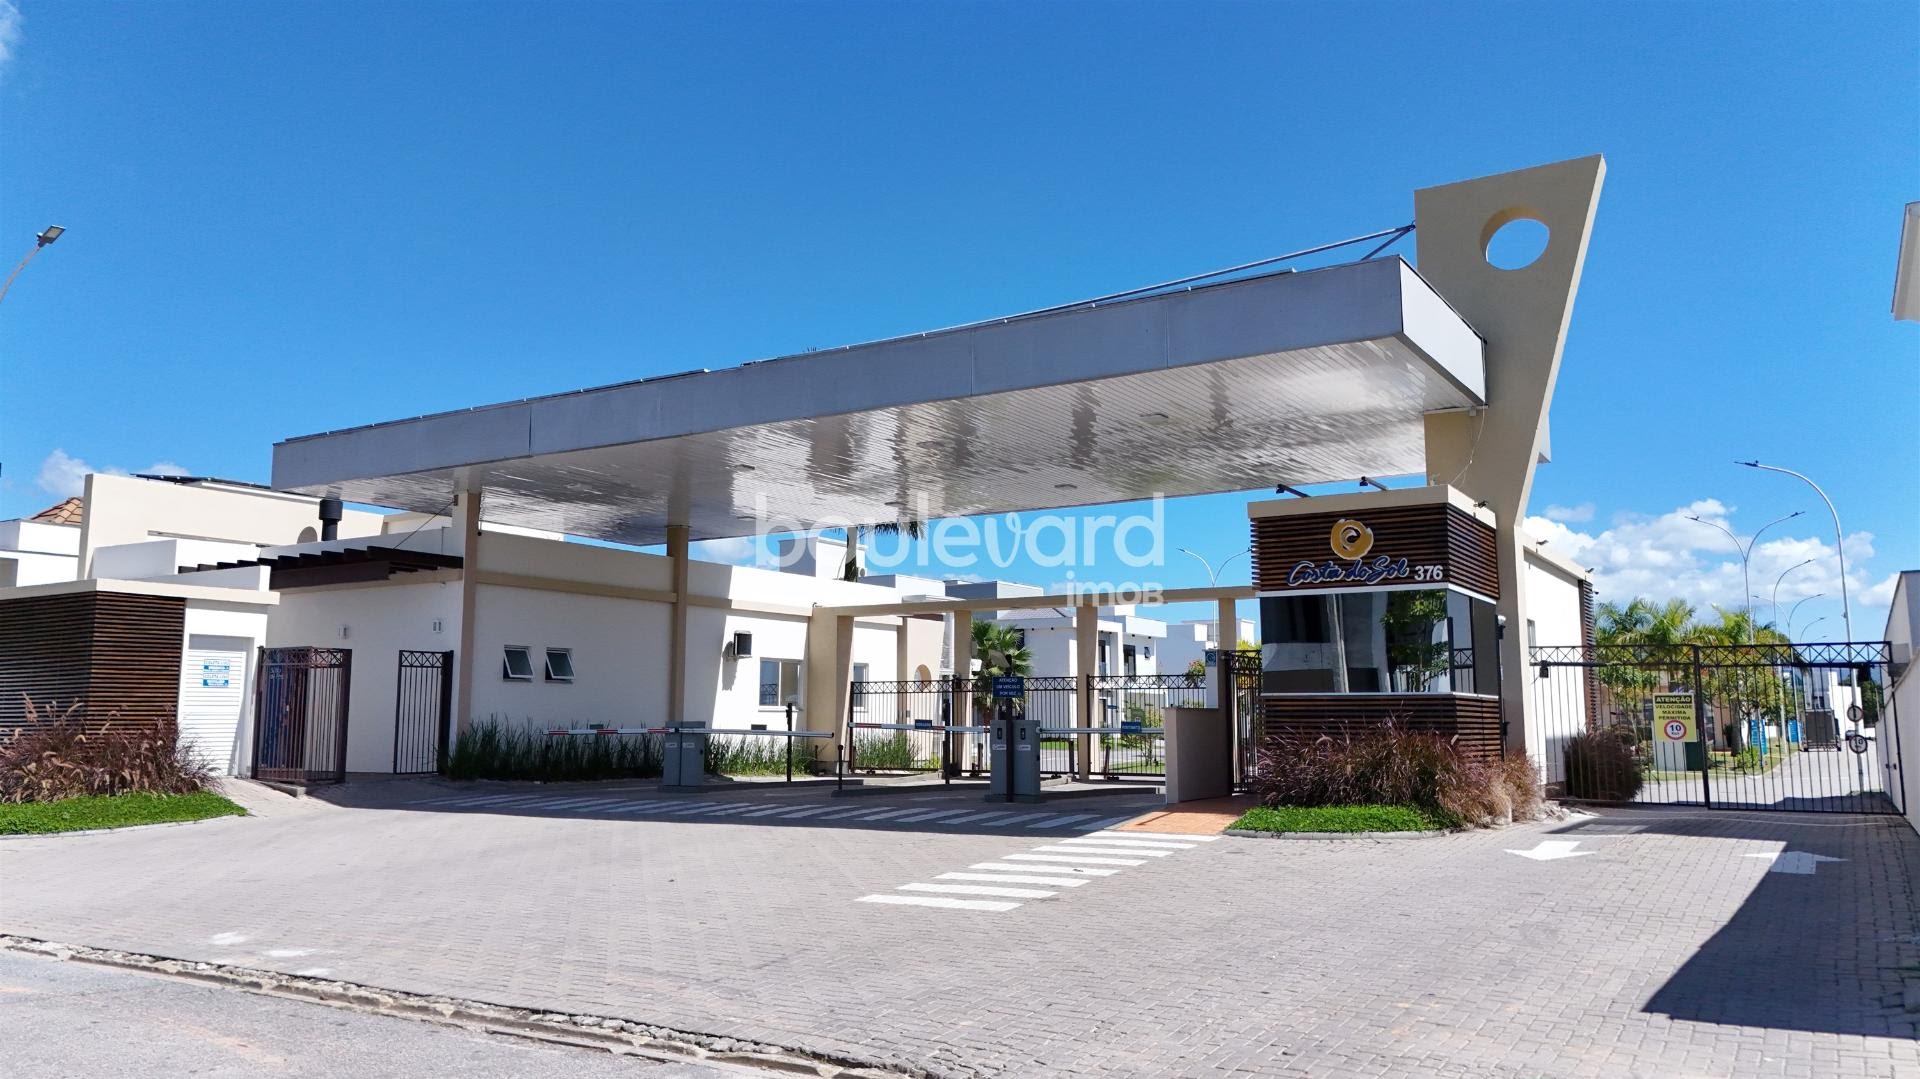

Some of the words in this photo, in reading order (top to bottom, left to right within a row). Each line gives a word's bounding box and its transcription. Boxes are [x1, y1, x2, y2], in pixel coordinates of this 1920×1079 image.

[1288, 561, 1345, 586] Costa
[1344, 559, 1372, 581] do
[1366, 556, 1410, 585] Sol
[1414, 565, 1443, 580] 376
[1656, 696, 1691, 704] ATENÇÃO
[1670, 724, 1682, 732] 10
